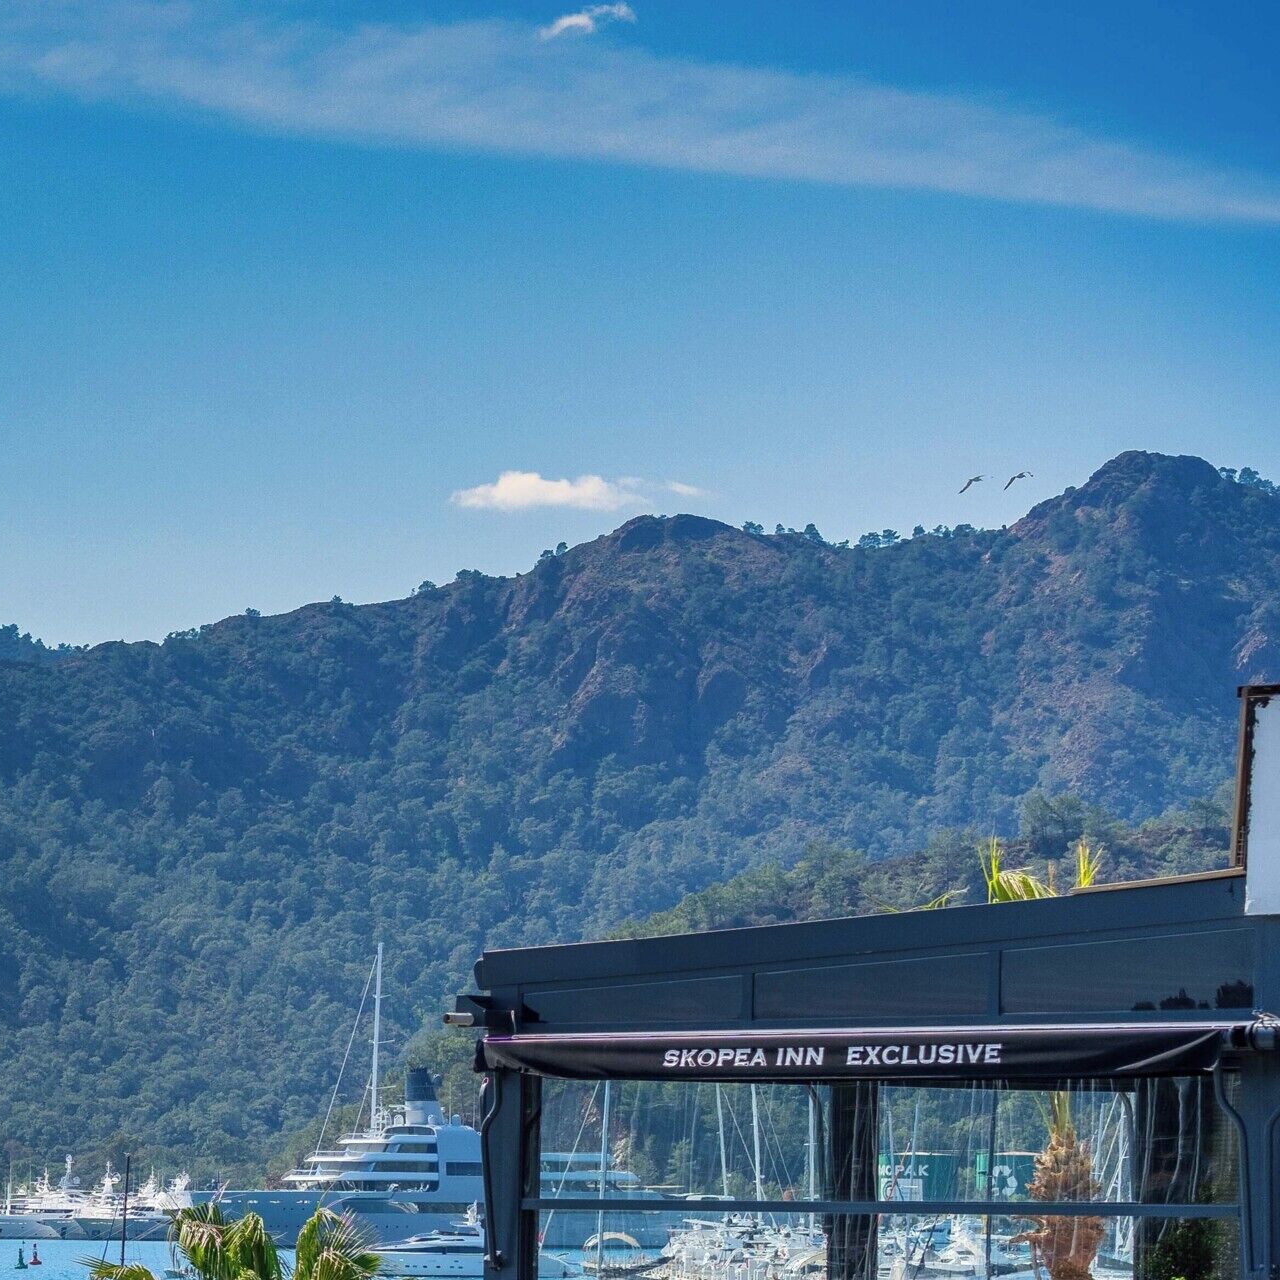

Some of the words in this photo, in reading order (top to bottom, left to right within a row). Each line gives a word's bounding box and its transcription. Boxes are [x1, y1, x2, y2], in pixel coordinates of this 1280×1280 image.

[662, 1048, 767, 1067] SKOPEA
[776, 1047, 824, 1066] INN
[846, 1043, 1002, 1065] EXCLUSIVE
